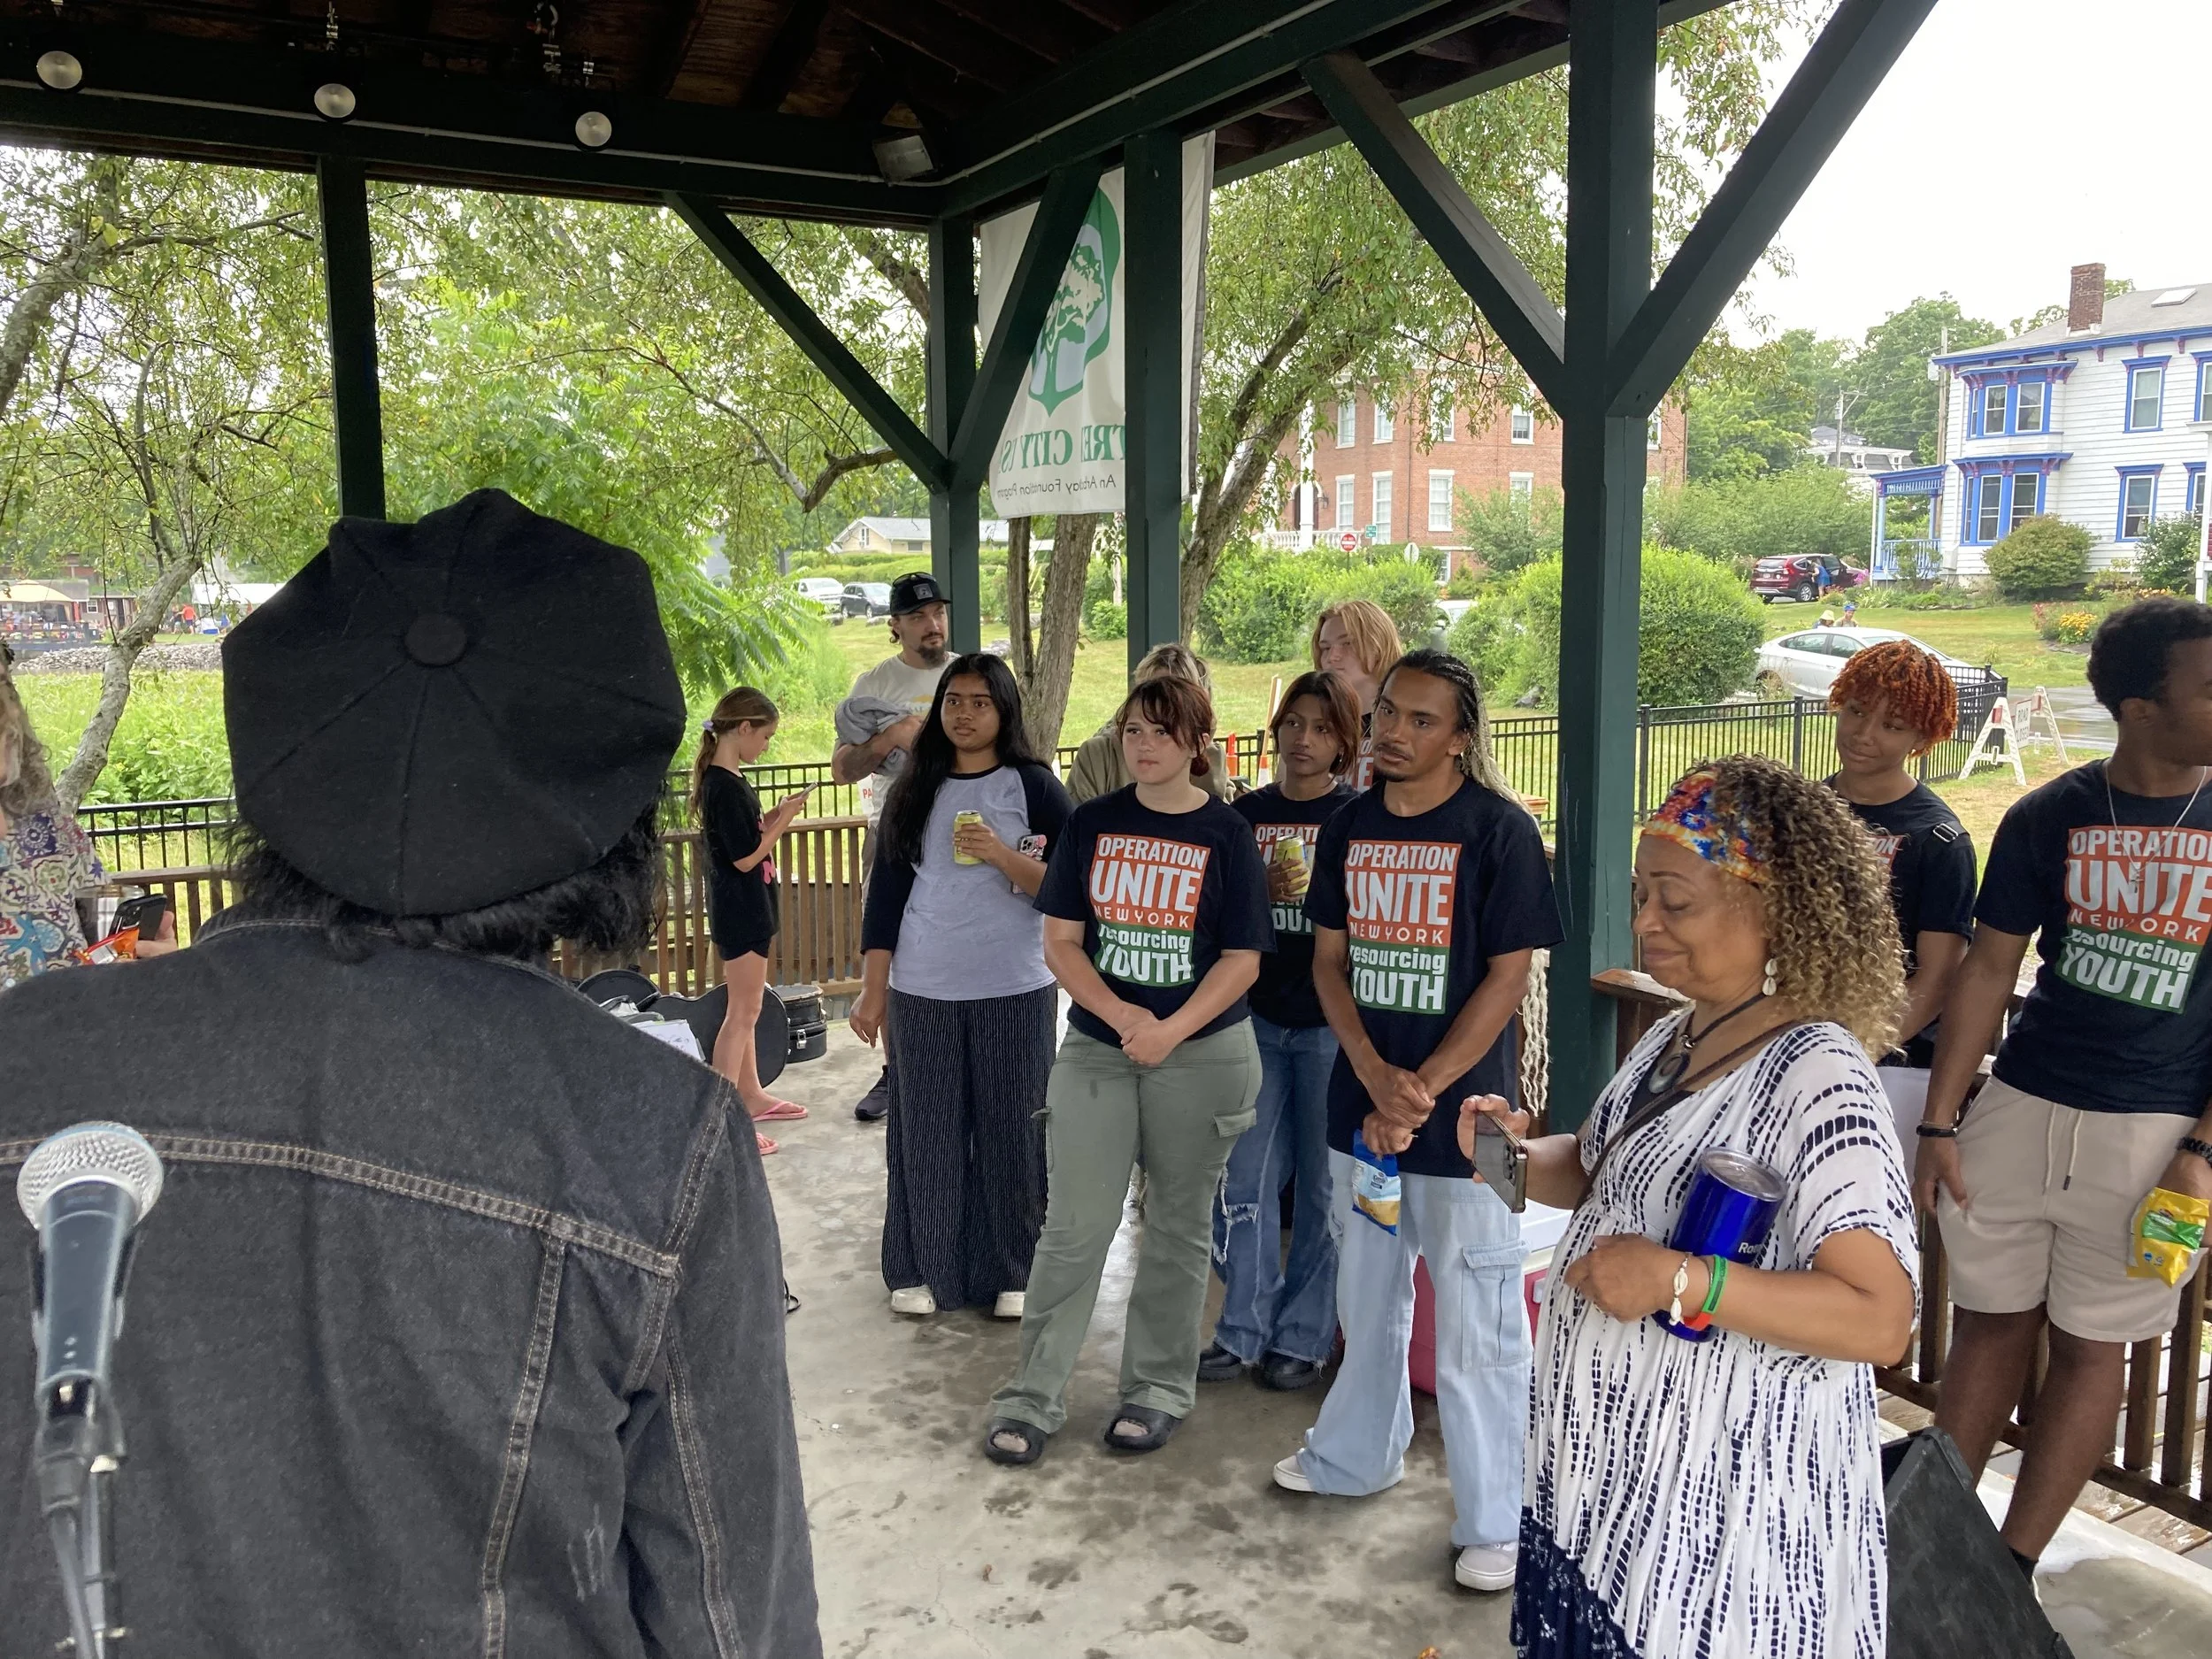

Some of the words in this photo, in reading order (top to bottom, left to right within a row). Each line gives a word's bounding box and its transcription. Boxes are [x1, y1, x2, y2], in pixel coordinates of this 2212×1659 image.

[1256, 826, 1318, 842] OPERATI
[2071, 829, 2212, 862] OPERATIO
[1098, 836, 1207, 870] OPERATION
[1347, 843, 1458, 872] OPERATION
[1091, 860, 1201, 913] UNITE
[1346, 871, 1452, 926] UNITE
[2069, 859, 2212, 922] UNITE
[1094, 905, 1129, 921] NEW
[1134, 910, 1189, 928] YORK
[1350, 922, 1380, 939] NEW
[1385, 926, 1444, 945] YORK
[1100, 941, 1192, 983] YOUTH
[1349, 945, 1447, 975] resourcing
[2062, 942, 2189, 1009] YOUTH
